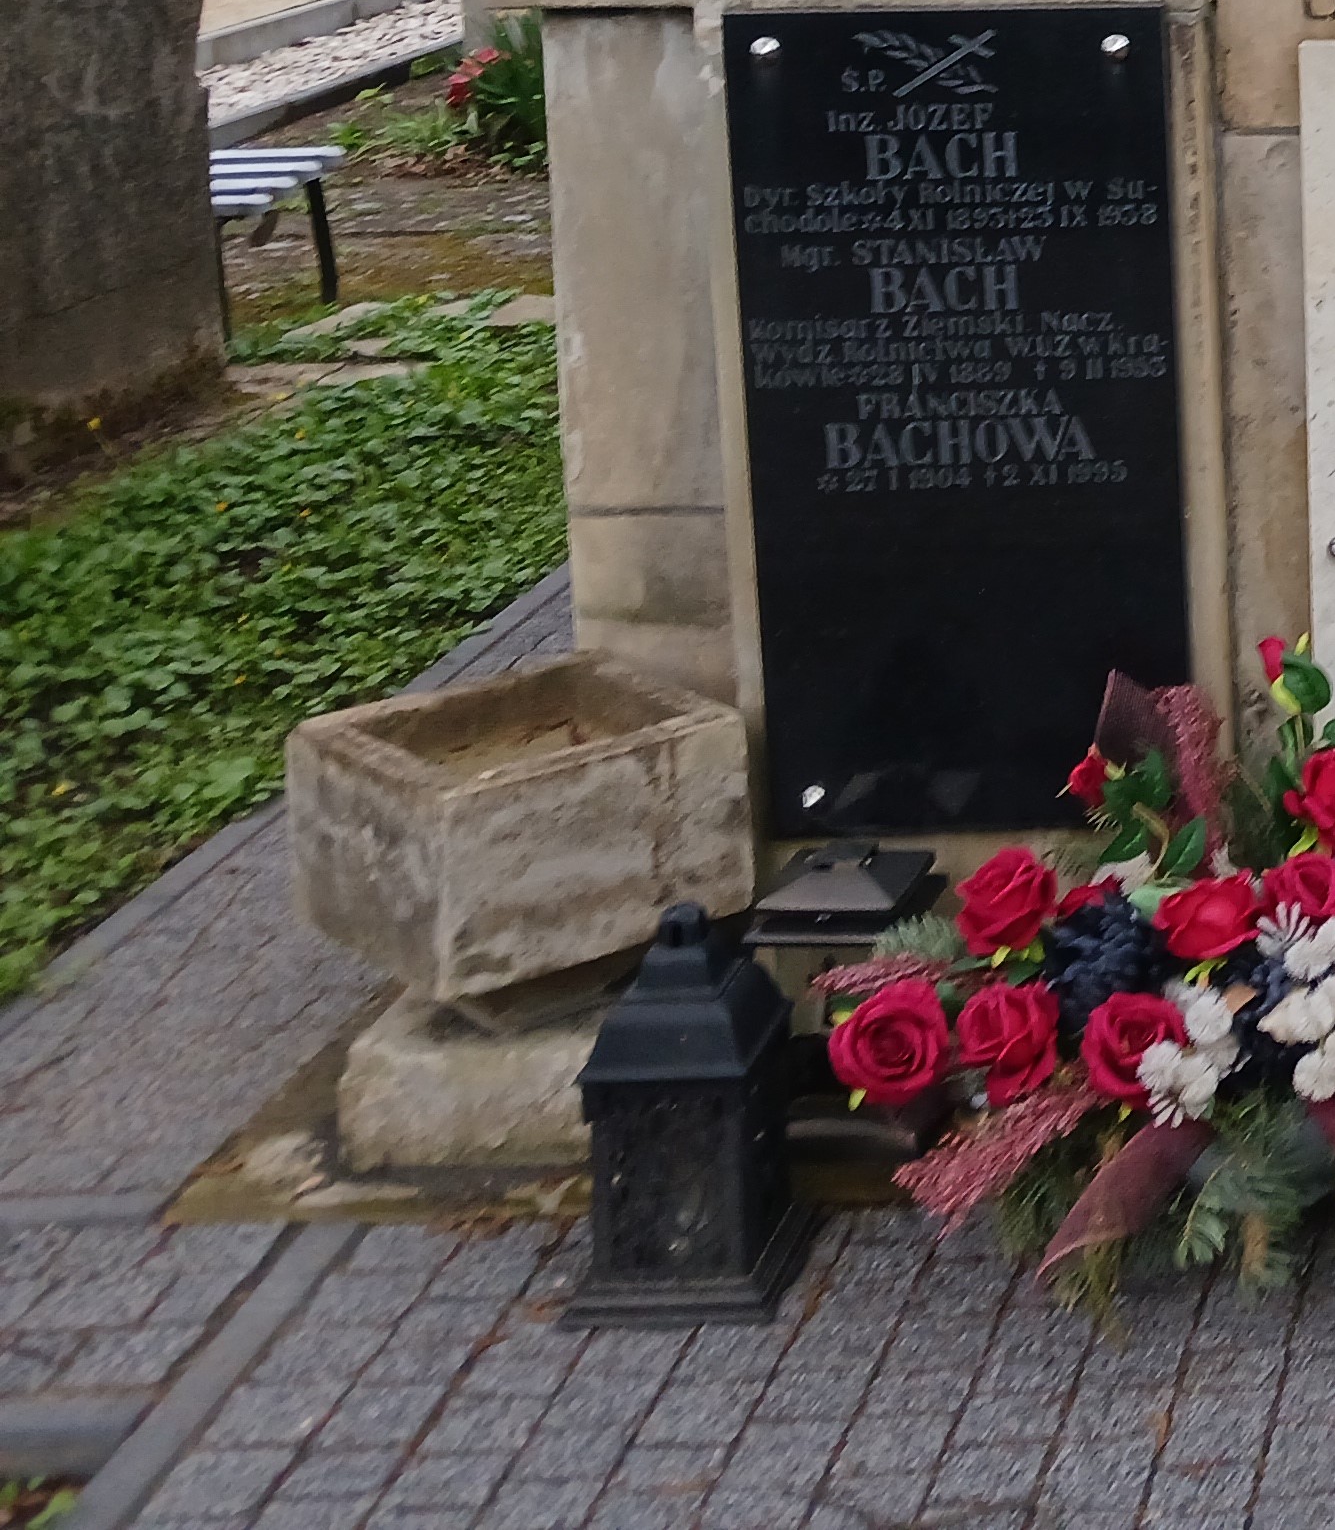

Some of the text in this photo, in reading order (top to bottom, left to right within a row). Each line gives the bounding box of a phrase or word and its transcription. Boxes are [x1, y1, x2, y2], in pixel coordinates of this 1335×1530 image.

[864, 130, 1020, 180] BACH
[919, 179, 1055, 207] Rolniczej
[1060, 205, 1088, 227] IX
[851, 235, 1047, 264] STANISŁAW
[868, 264, 1020, 313] BACH
[856, 387, 1065, 419] FRANCISZKA
[824, 414, 1097, 470] BACHOWA
